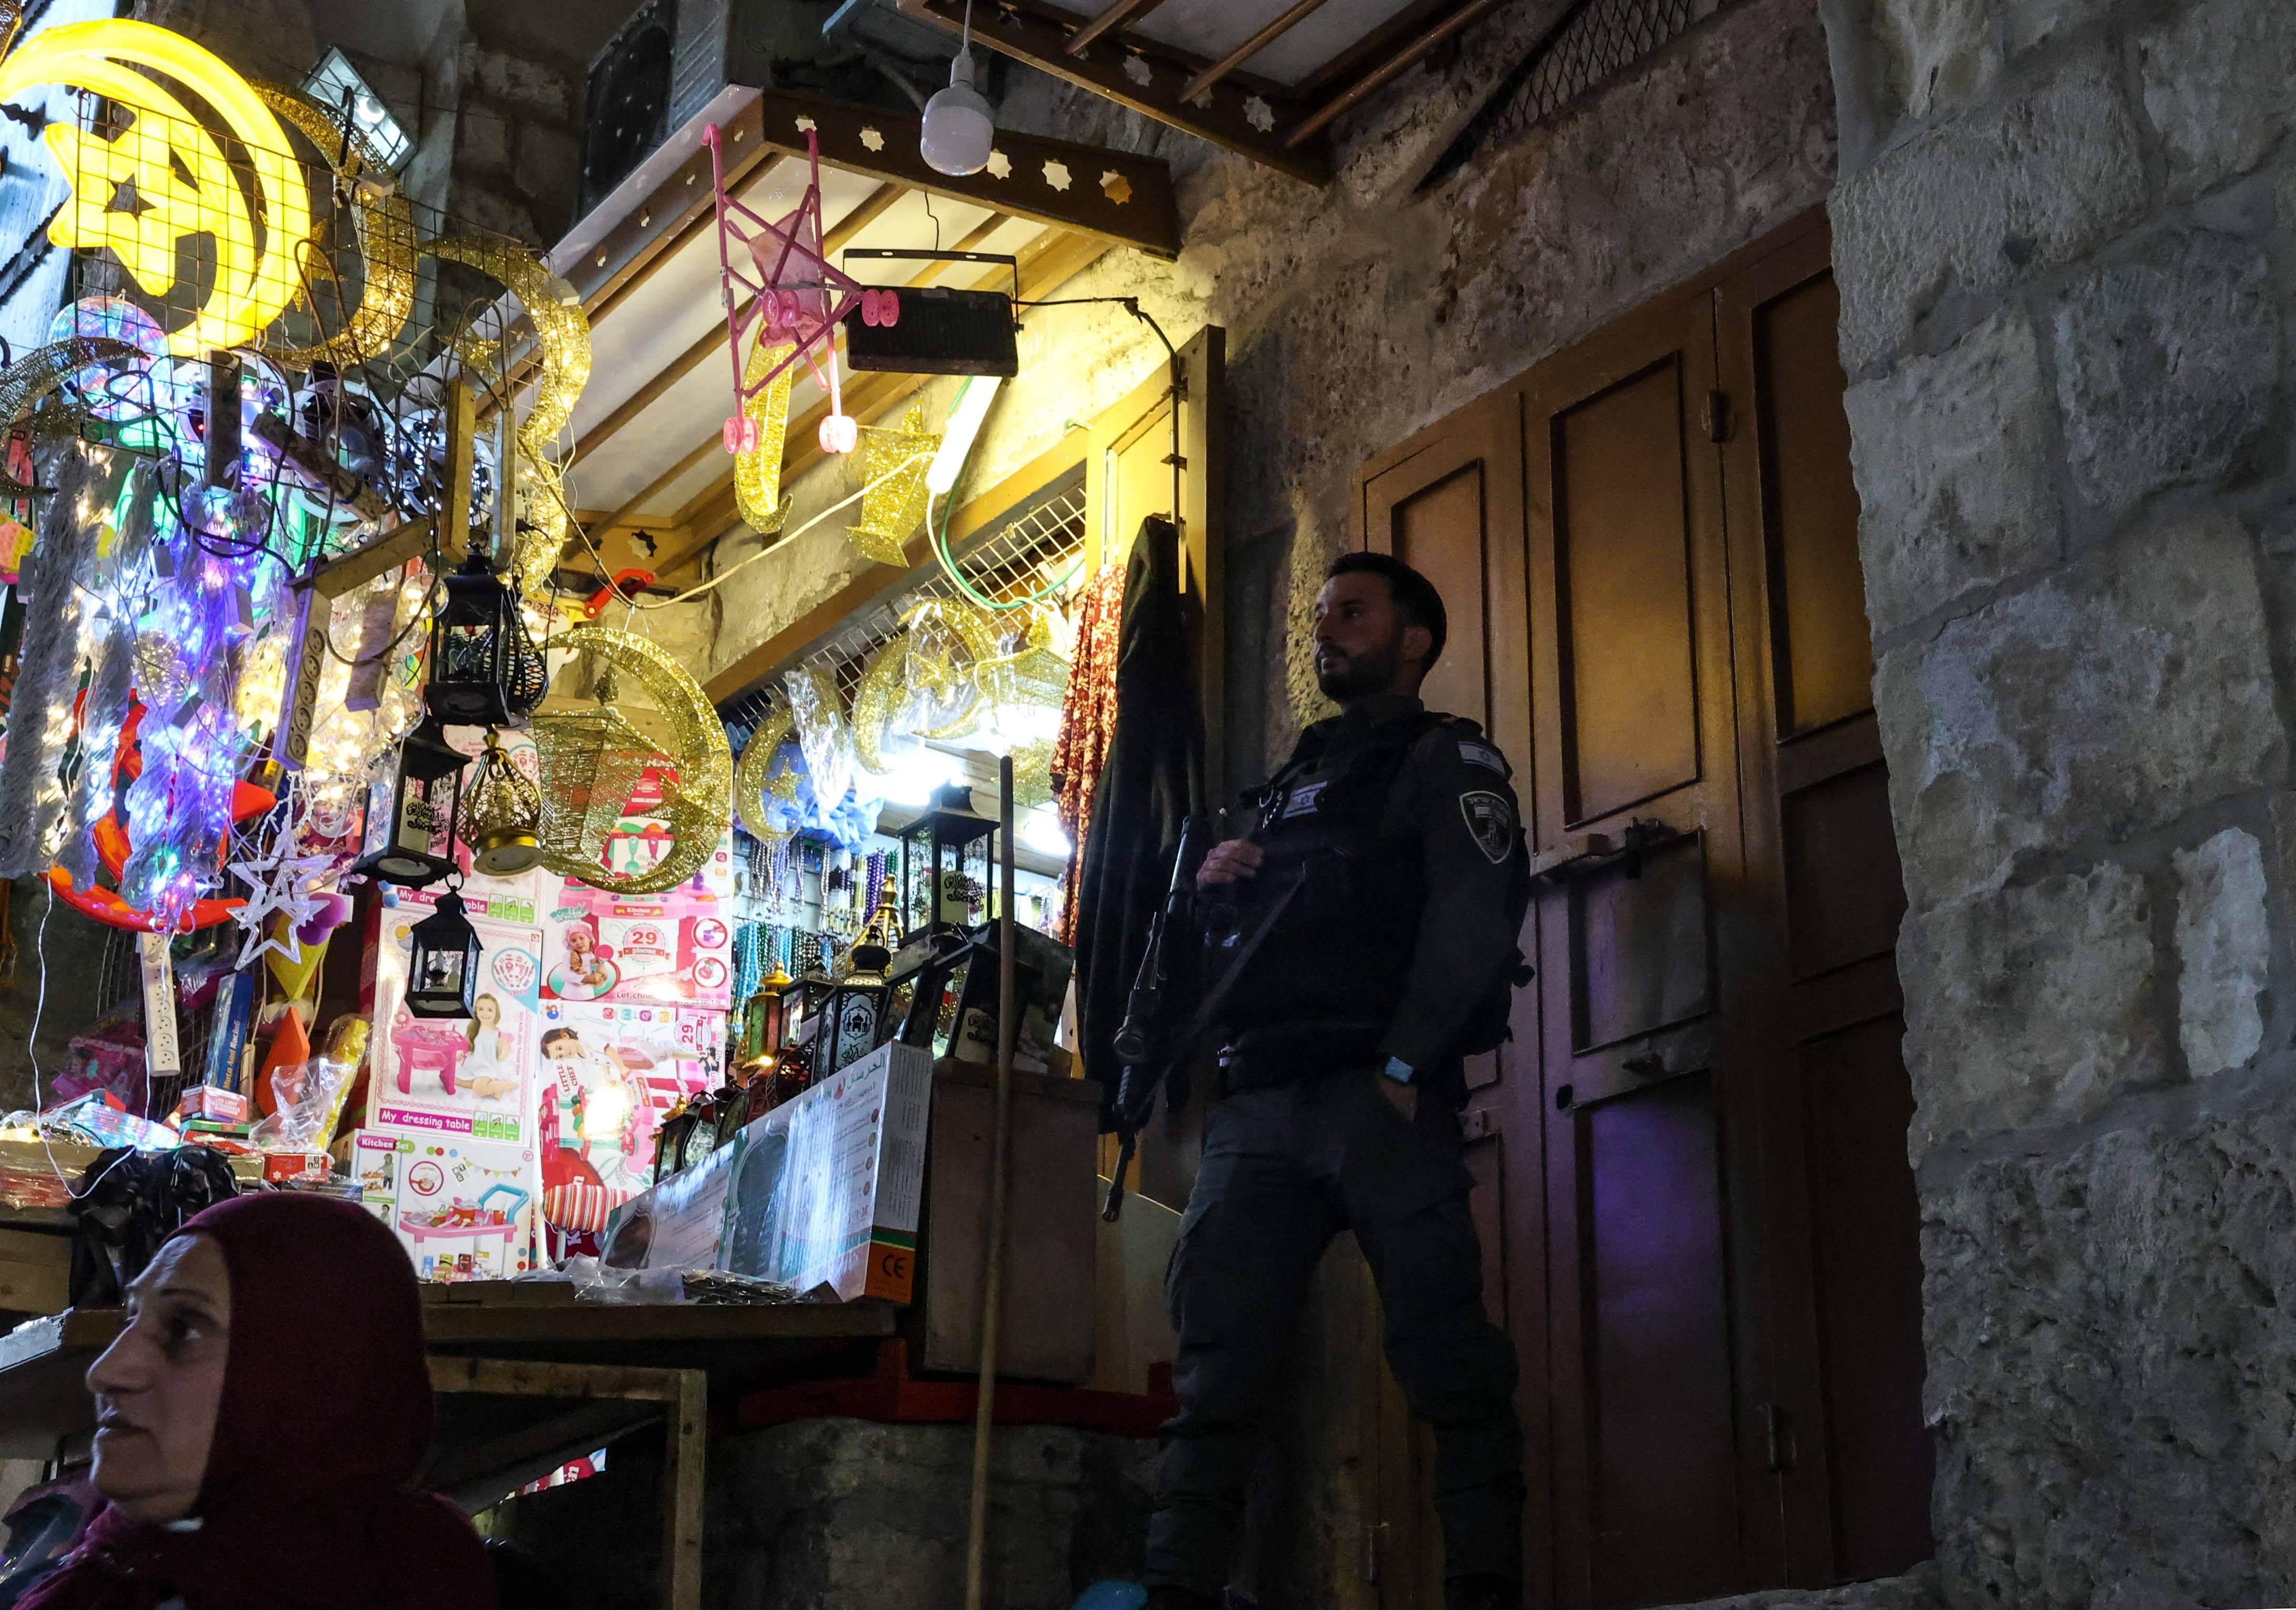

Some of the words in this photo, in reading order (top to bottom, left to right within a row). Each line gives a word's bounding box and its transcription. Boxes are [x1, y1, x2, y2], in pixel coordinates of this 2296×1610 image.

[523, 599, 559, 616] PIZZA
[399, 890, 413, 902] My
[466, 900, 485, 912] able
[632, 931, 657, 945] 29
[682, 1024, 693, 1044] 29
[556, 1064, 571, 1092] LITTLE
[566, 1065, 578, 1086] CHEF
[381, 1110, 397, 1123] My
[402, 1113, 443, 1129] dressing
[445, 1118, 470, 1130] table
[361, 1138, 393, 1148] Kitchen
[395, 1139, 409, 1150] Set
[882, 1254, 906, 1279] CE
